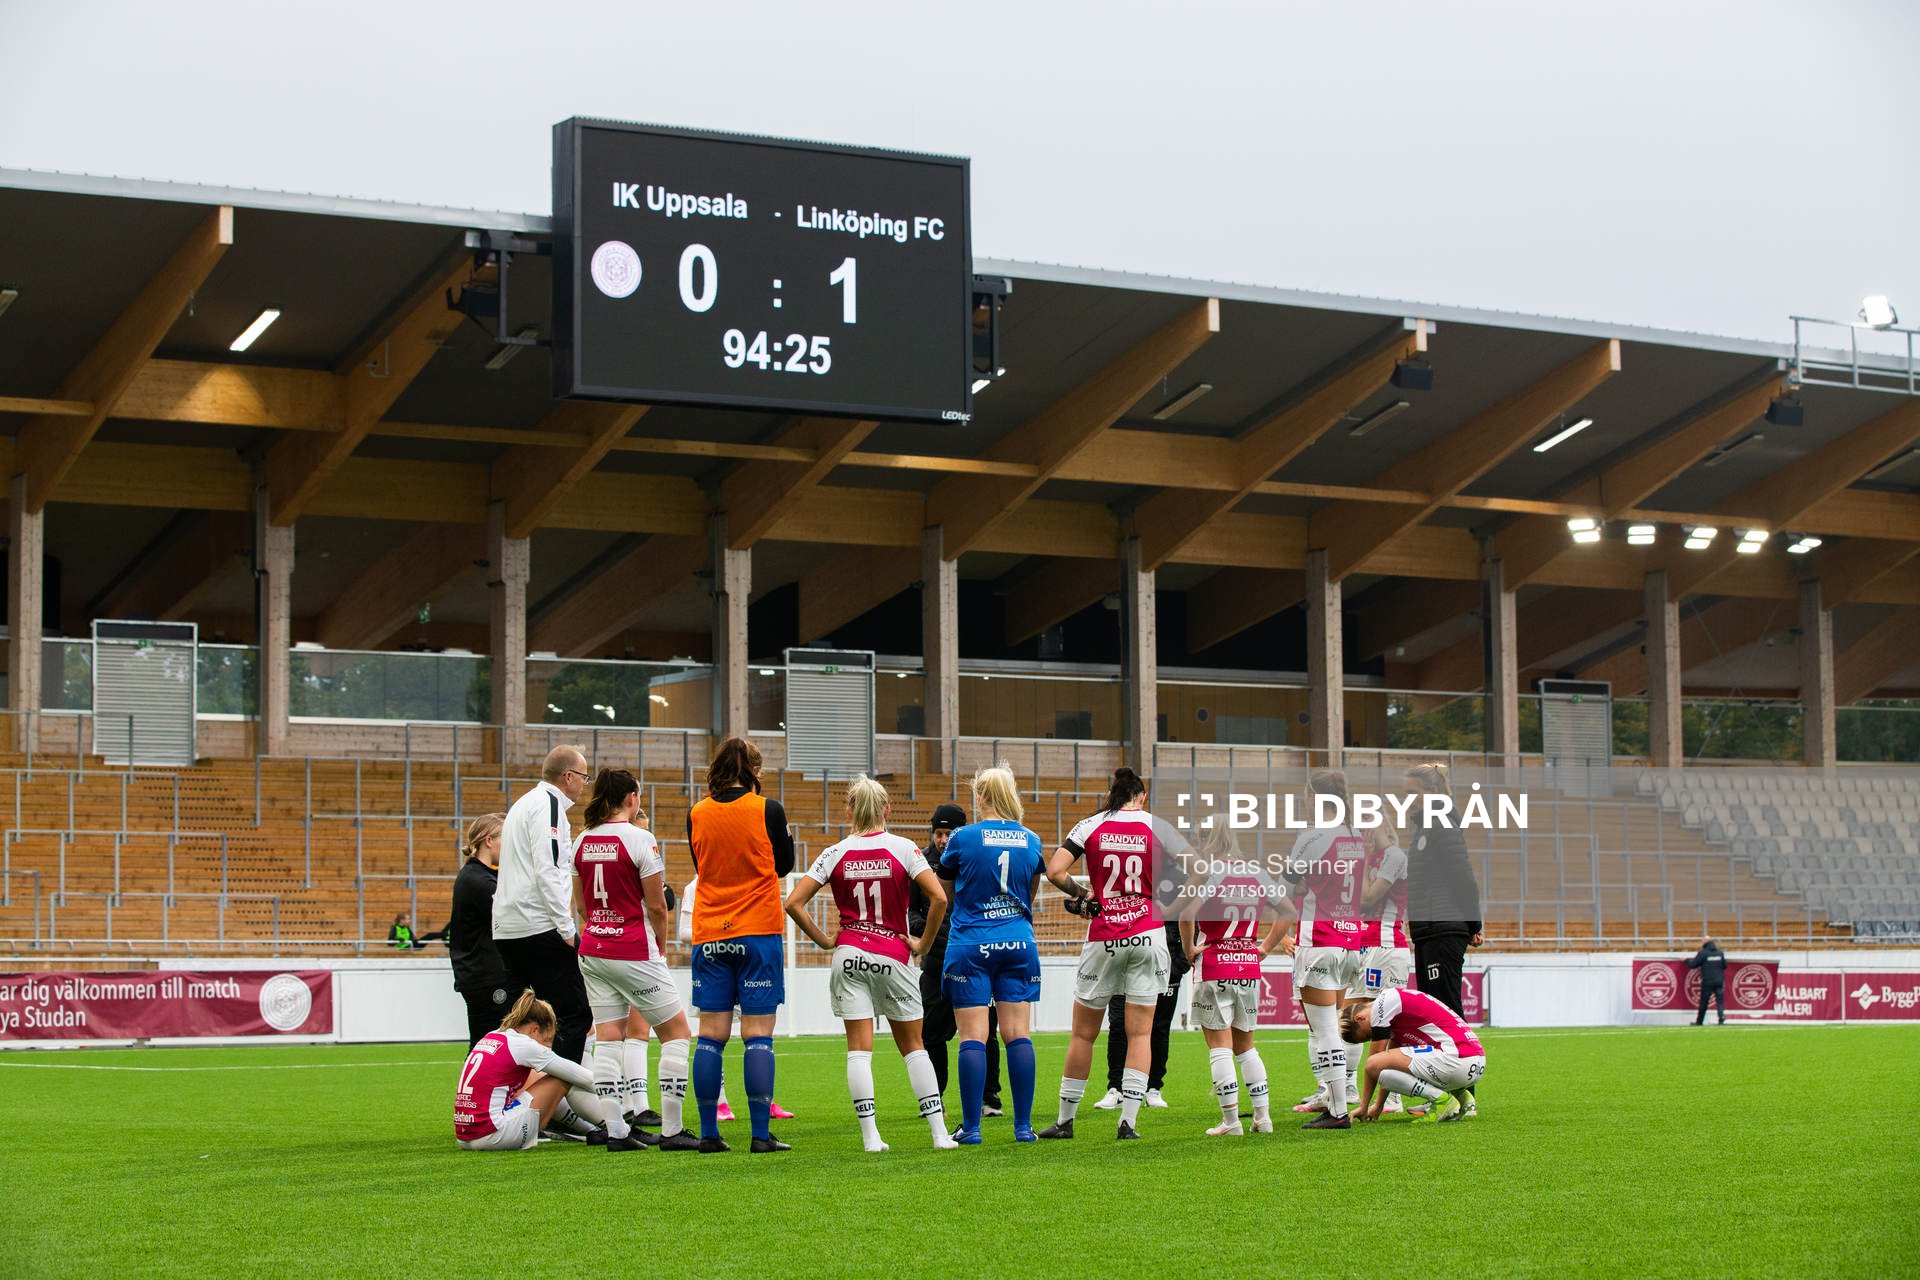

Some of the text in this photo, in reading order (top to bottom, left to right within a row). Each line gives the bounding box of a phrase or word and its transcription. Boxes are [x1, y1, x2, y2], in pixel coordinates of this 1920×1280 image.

[613, 182, 639, 208] IK
[647, 185, 748, 219] Uppsala
[797, 205, 908, 242] Linköping
[914, 217, 945, 240] FC
[678, 243, 718, 313] 0
[829, 256, 857, 323] 1
[723, 328, 832, 375] 94:25
[942, 410, 971, 421] LEDtec
[984, 830, 1026, 840] SANDVIK
[1101, 834, 1145, 845] SANDVIK
[583, 844, 617, 853] SANDVIK
[844, 860, 890, 871] SANDVIK
[997, 850, 1010, 893] 1
[1102, 854, 1143, 899] 28
[593, 863, 608, 909] 4
[853, 880, 883, 925] 11
[702, 942, 746, 962] gibon
[1104, 936, 1151, 957] gibon
[1217, 952, 1258, 962] relation
[843, 956, 892, 978] gibon
[21, 978, 50, 1007] dig
[54, 978, 156, 1001] välkommen
[161, 977, 183, 1000] till
[188, 976, 241, 999] match
[744, 979, 772, 988] knowit
[24, 1005, 86, 1028] Studan
[457, 1052, 484, 1095] 12
